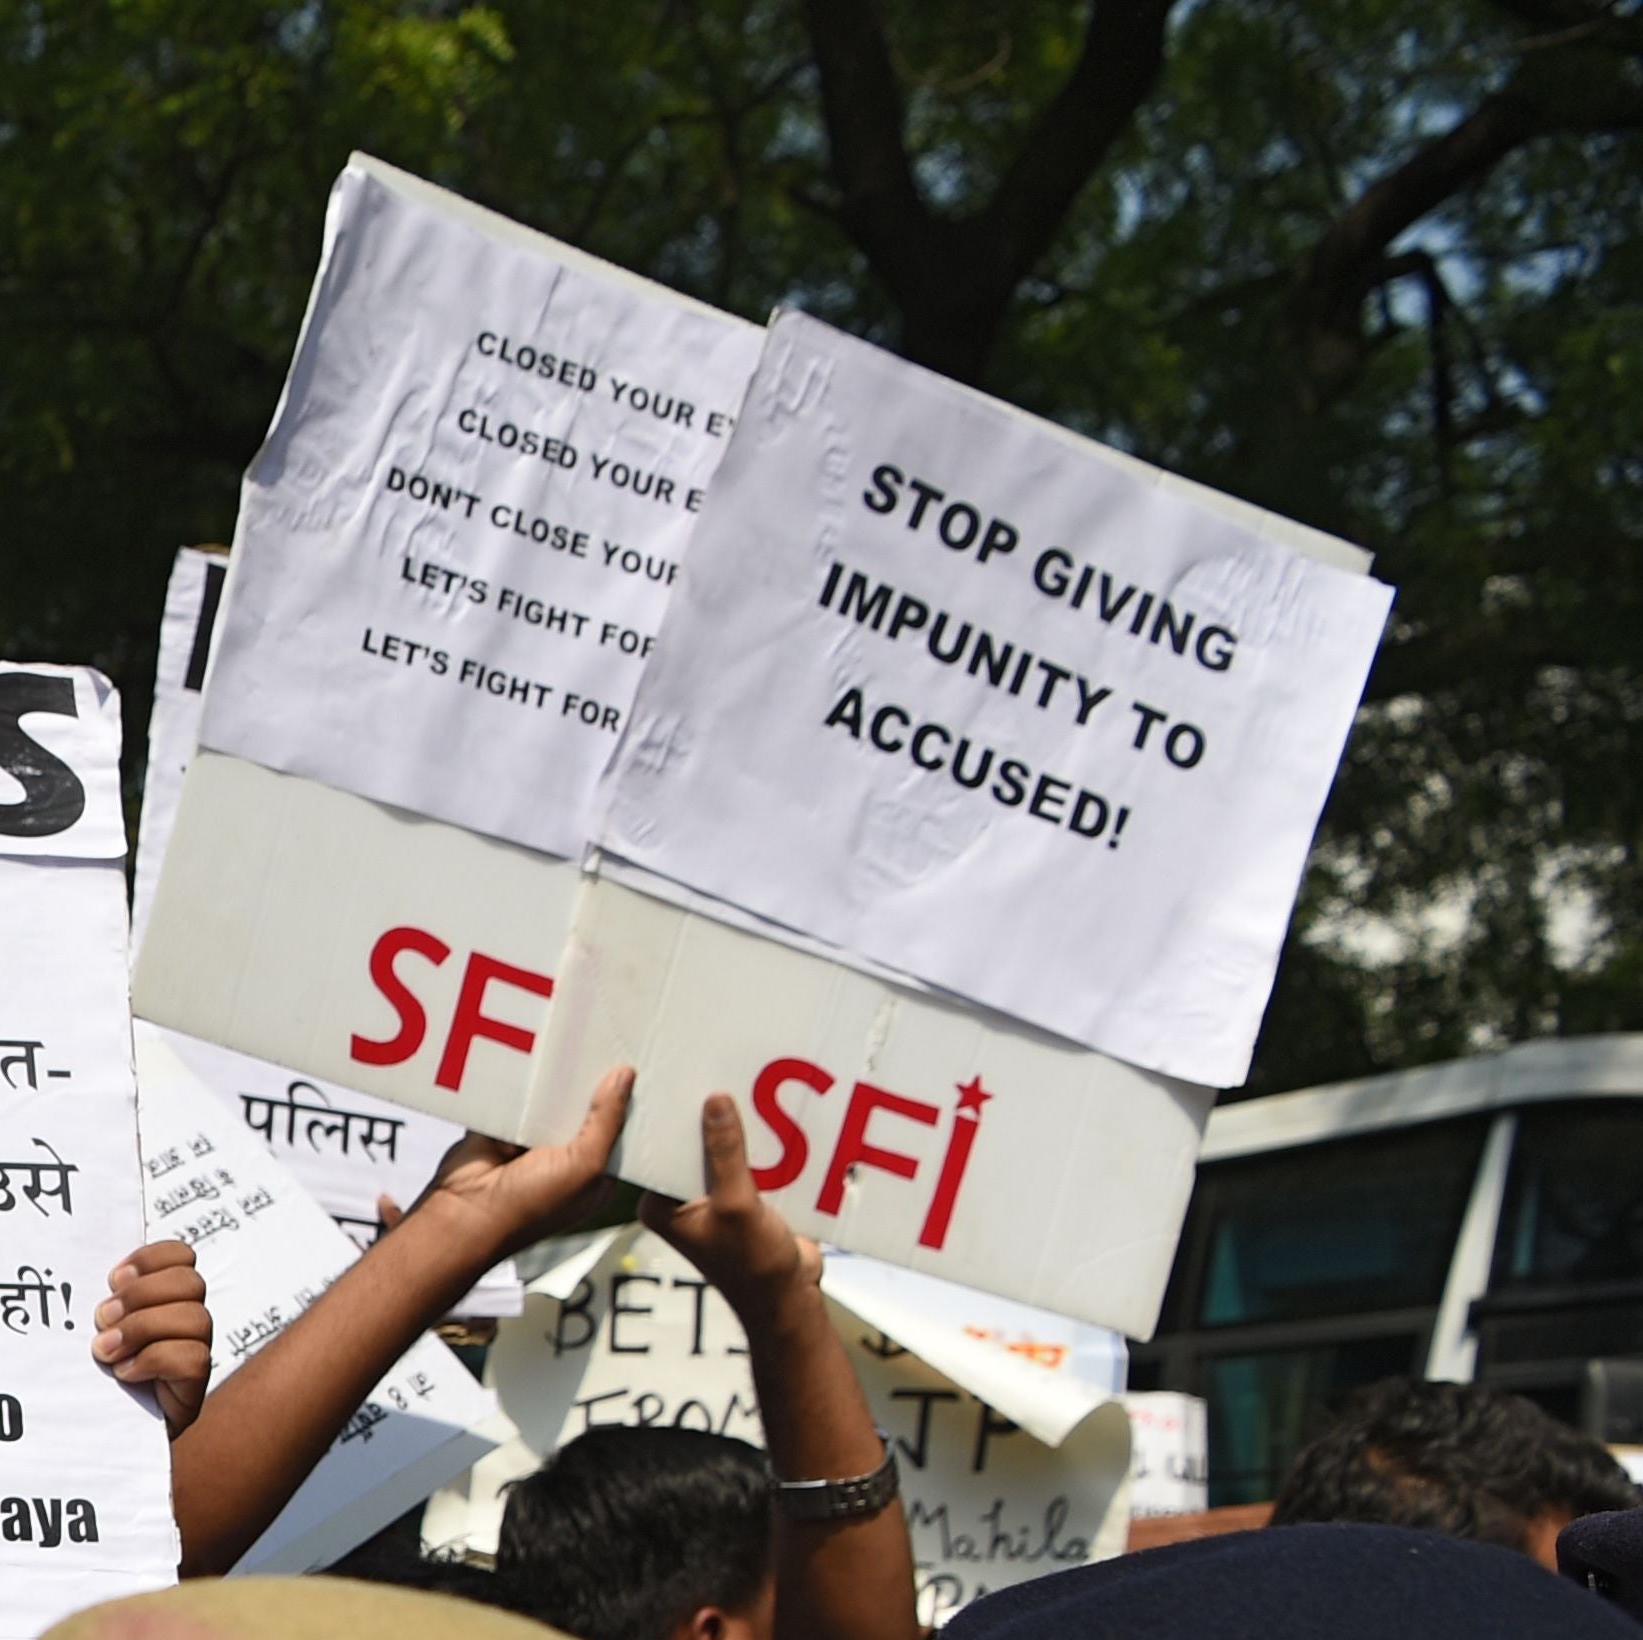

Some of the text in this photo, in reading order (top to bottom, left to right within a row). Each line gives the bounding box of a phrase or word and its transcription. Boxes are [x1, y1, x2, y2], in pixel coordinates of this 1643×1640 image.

[477, 331, 597, 392] CLOSED
[611, 379, 694, 430] YOUR
[458, 409, 578, 470] CLOSED
[592, 454, 675, 504] YOUR
[386, 467, 482, 519] DON'T
[491, 505, 589, 558] CLOSE
[401, 556, 487, 605] LET'S
[498, 589, 589, 639] FIGHT
[862, 464, 1238, 673] STOP GIVING
[362, 628, 621, 734] LET'S FIGHT FOR
[819, 561, 1205, 769] IMPUNITY TO
[825, 687, 1131, 849] ACCUSED!
